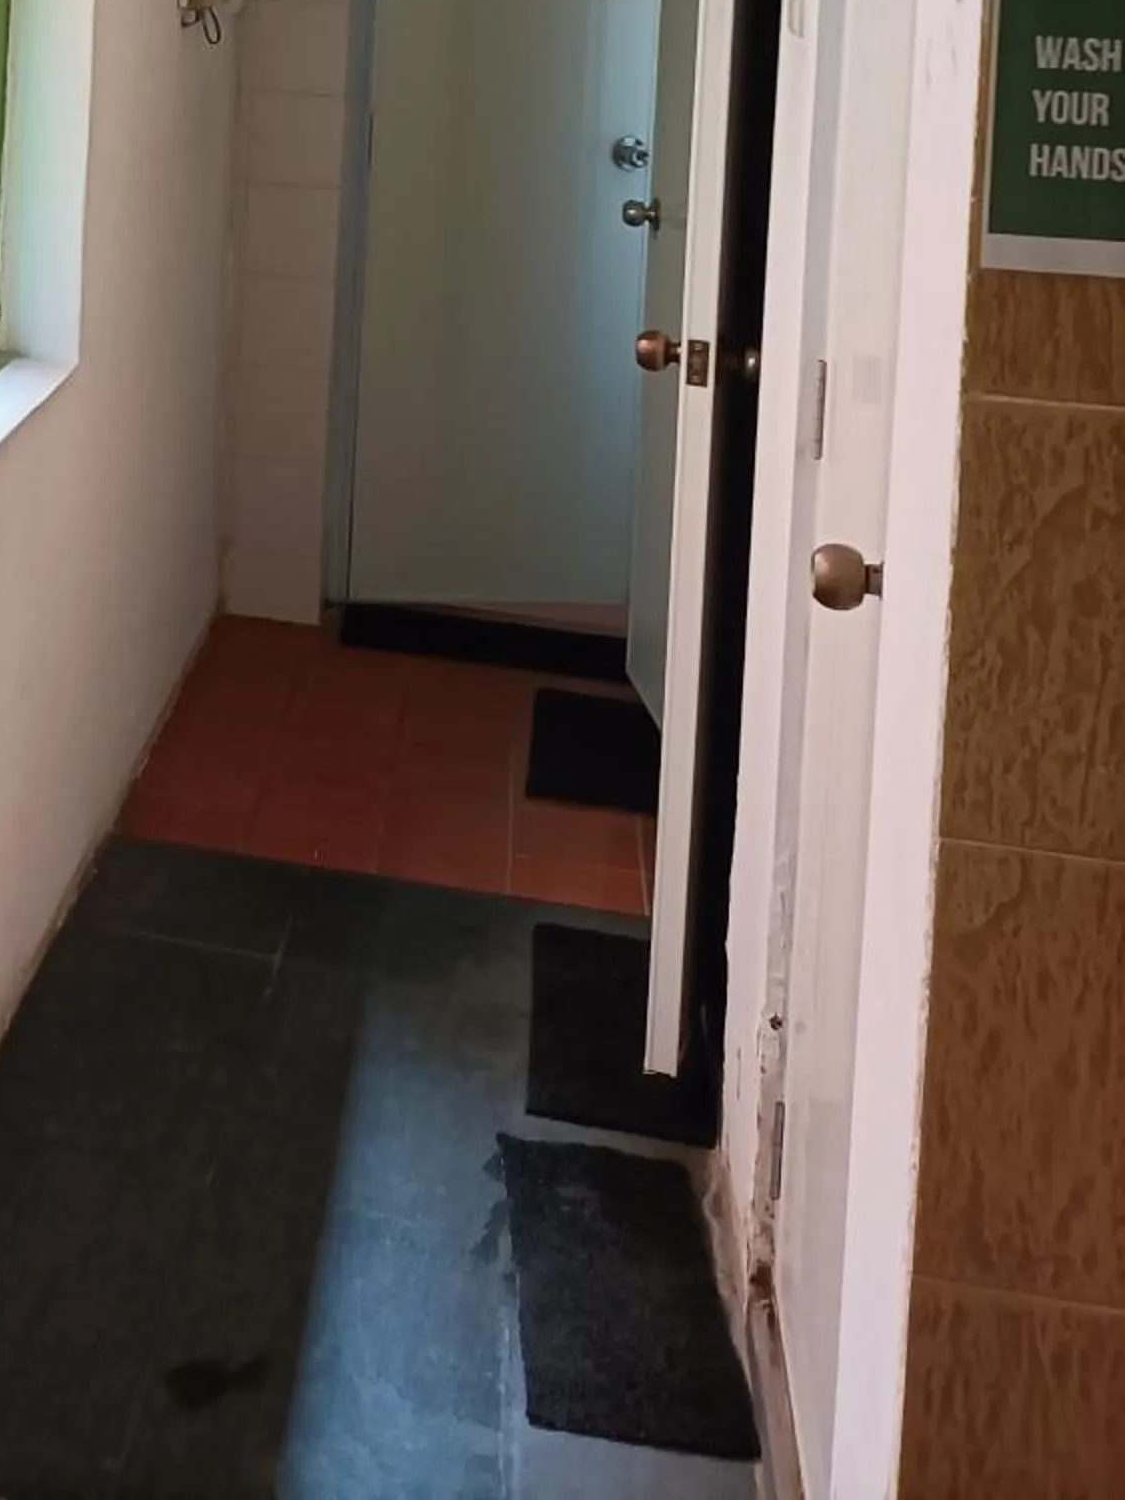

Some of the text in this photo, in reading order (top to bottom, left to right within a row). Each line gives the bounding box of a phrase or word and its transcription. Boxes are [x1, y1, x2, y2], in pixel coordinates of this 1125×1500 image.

[1035, 35, 1122, 72] WASH
[1032, 89, 1109, 127] YOUR
[1029, 143, 1125, 182] HANDS
